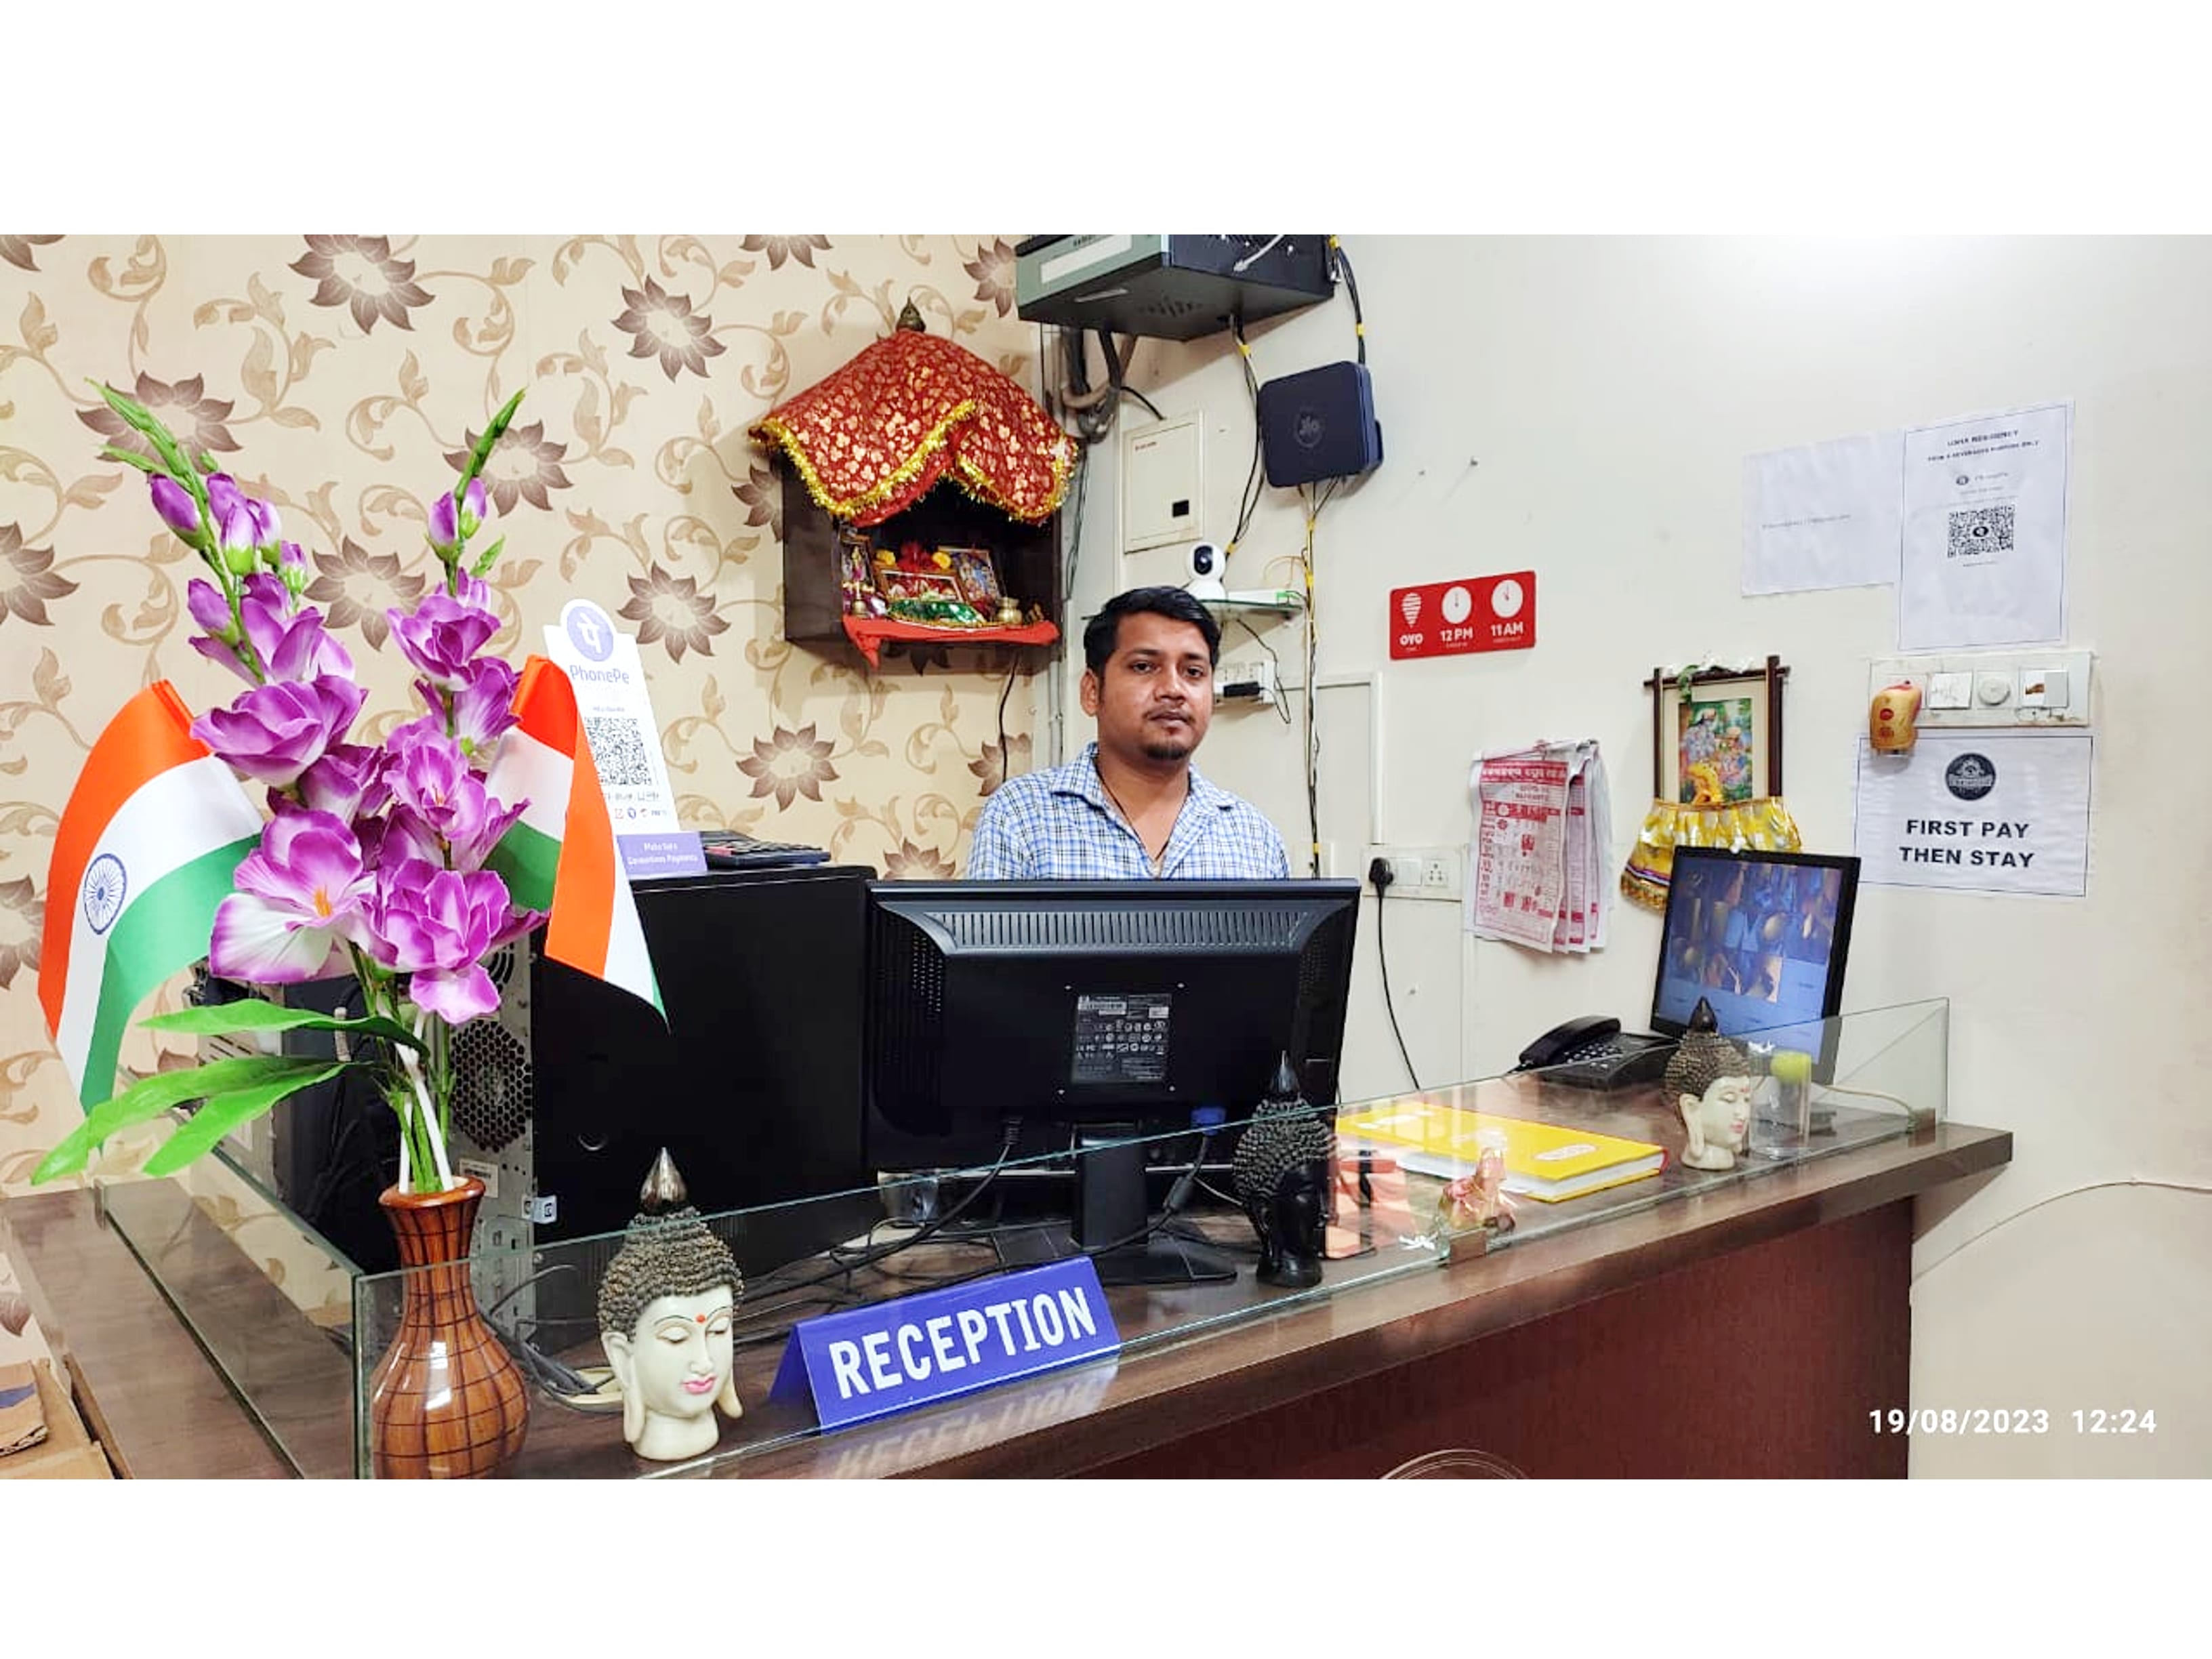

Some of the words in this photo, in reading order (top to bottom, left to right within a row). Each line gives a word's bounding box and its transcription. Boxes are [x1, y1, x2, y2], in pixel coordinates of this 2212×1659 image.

[1399, 633, 1423, 646] OYO
[569, 664, 630, 685] PhonePe
[1906, 819, 1973, 837] FIRST
[1981, 821, 2030, 839] PAY
[1899, 846, 1962, 865] THEN
[1970, 849, 2034, 868] STAY
[828, 1286, 1097, 1399] RECEPTION
